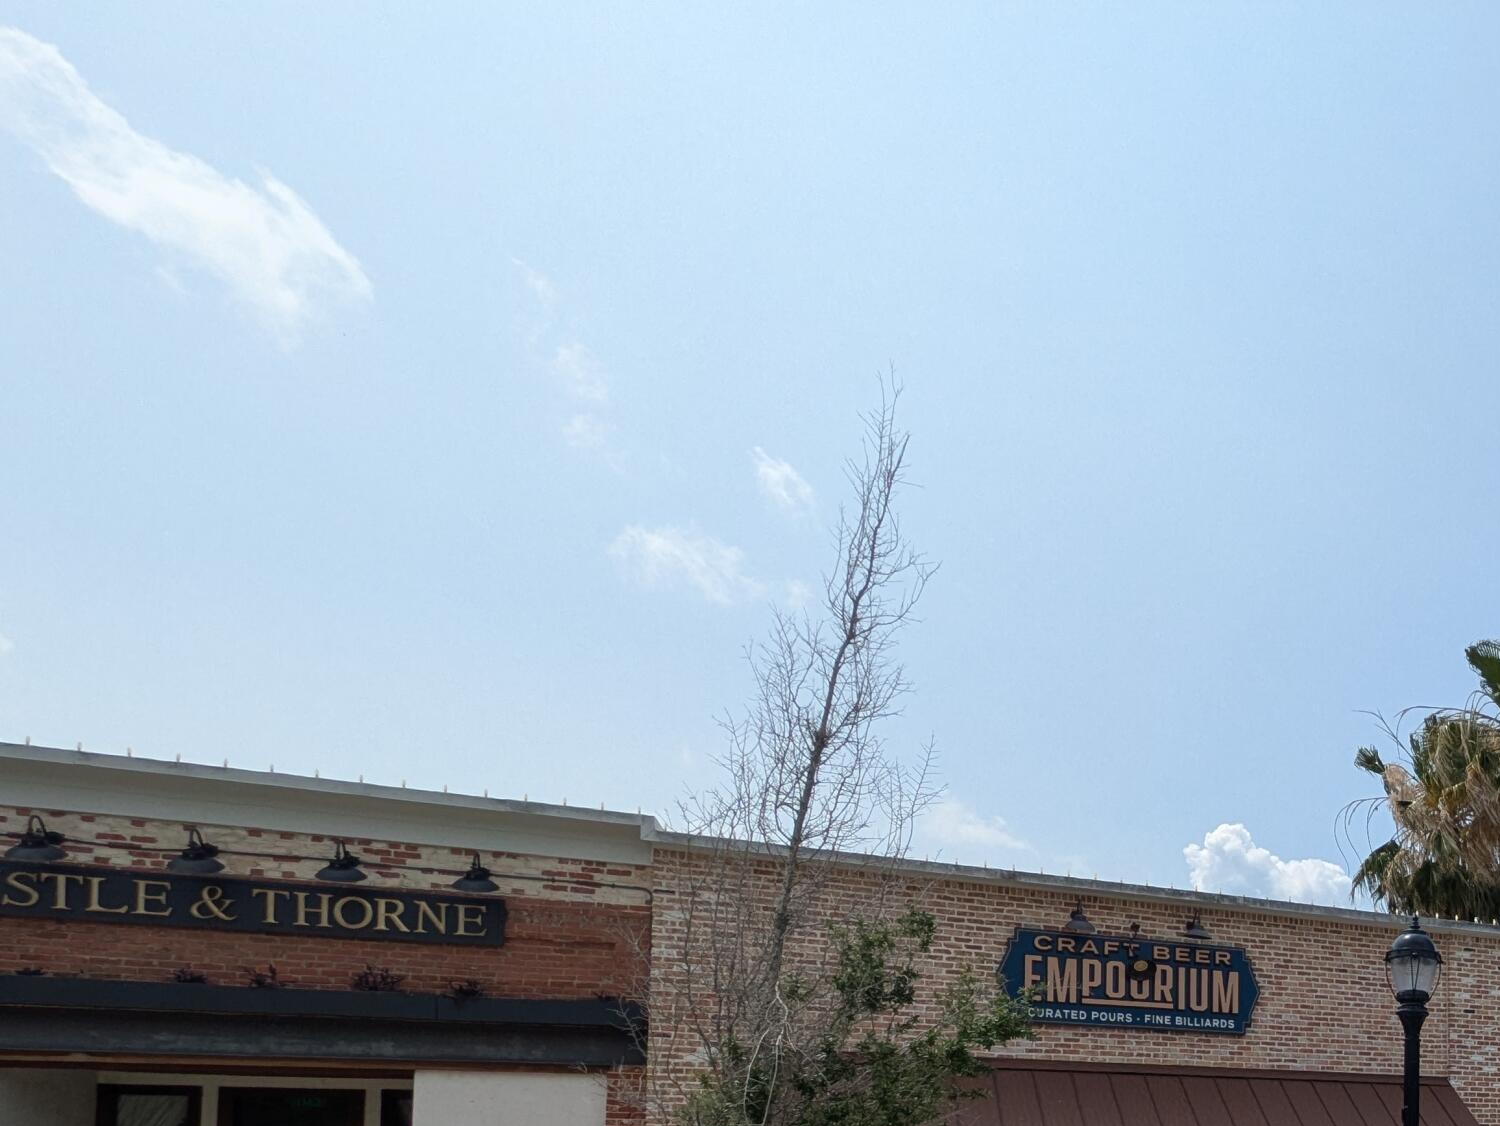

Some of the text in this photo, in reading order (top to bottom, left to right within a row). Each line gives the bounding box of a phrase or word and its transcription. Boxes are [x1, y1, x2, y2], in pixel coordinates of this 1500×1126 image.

[2, 871, 488, 937] STLE & THORNE
[1033, 935, 1232, 966] CRAFT BEER
[1027, 1007, 1235, 1029] CURATED POURS FINE BILLIARDS
